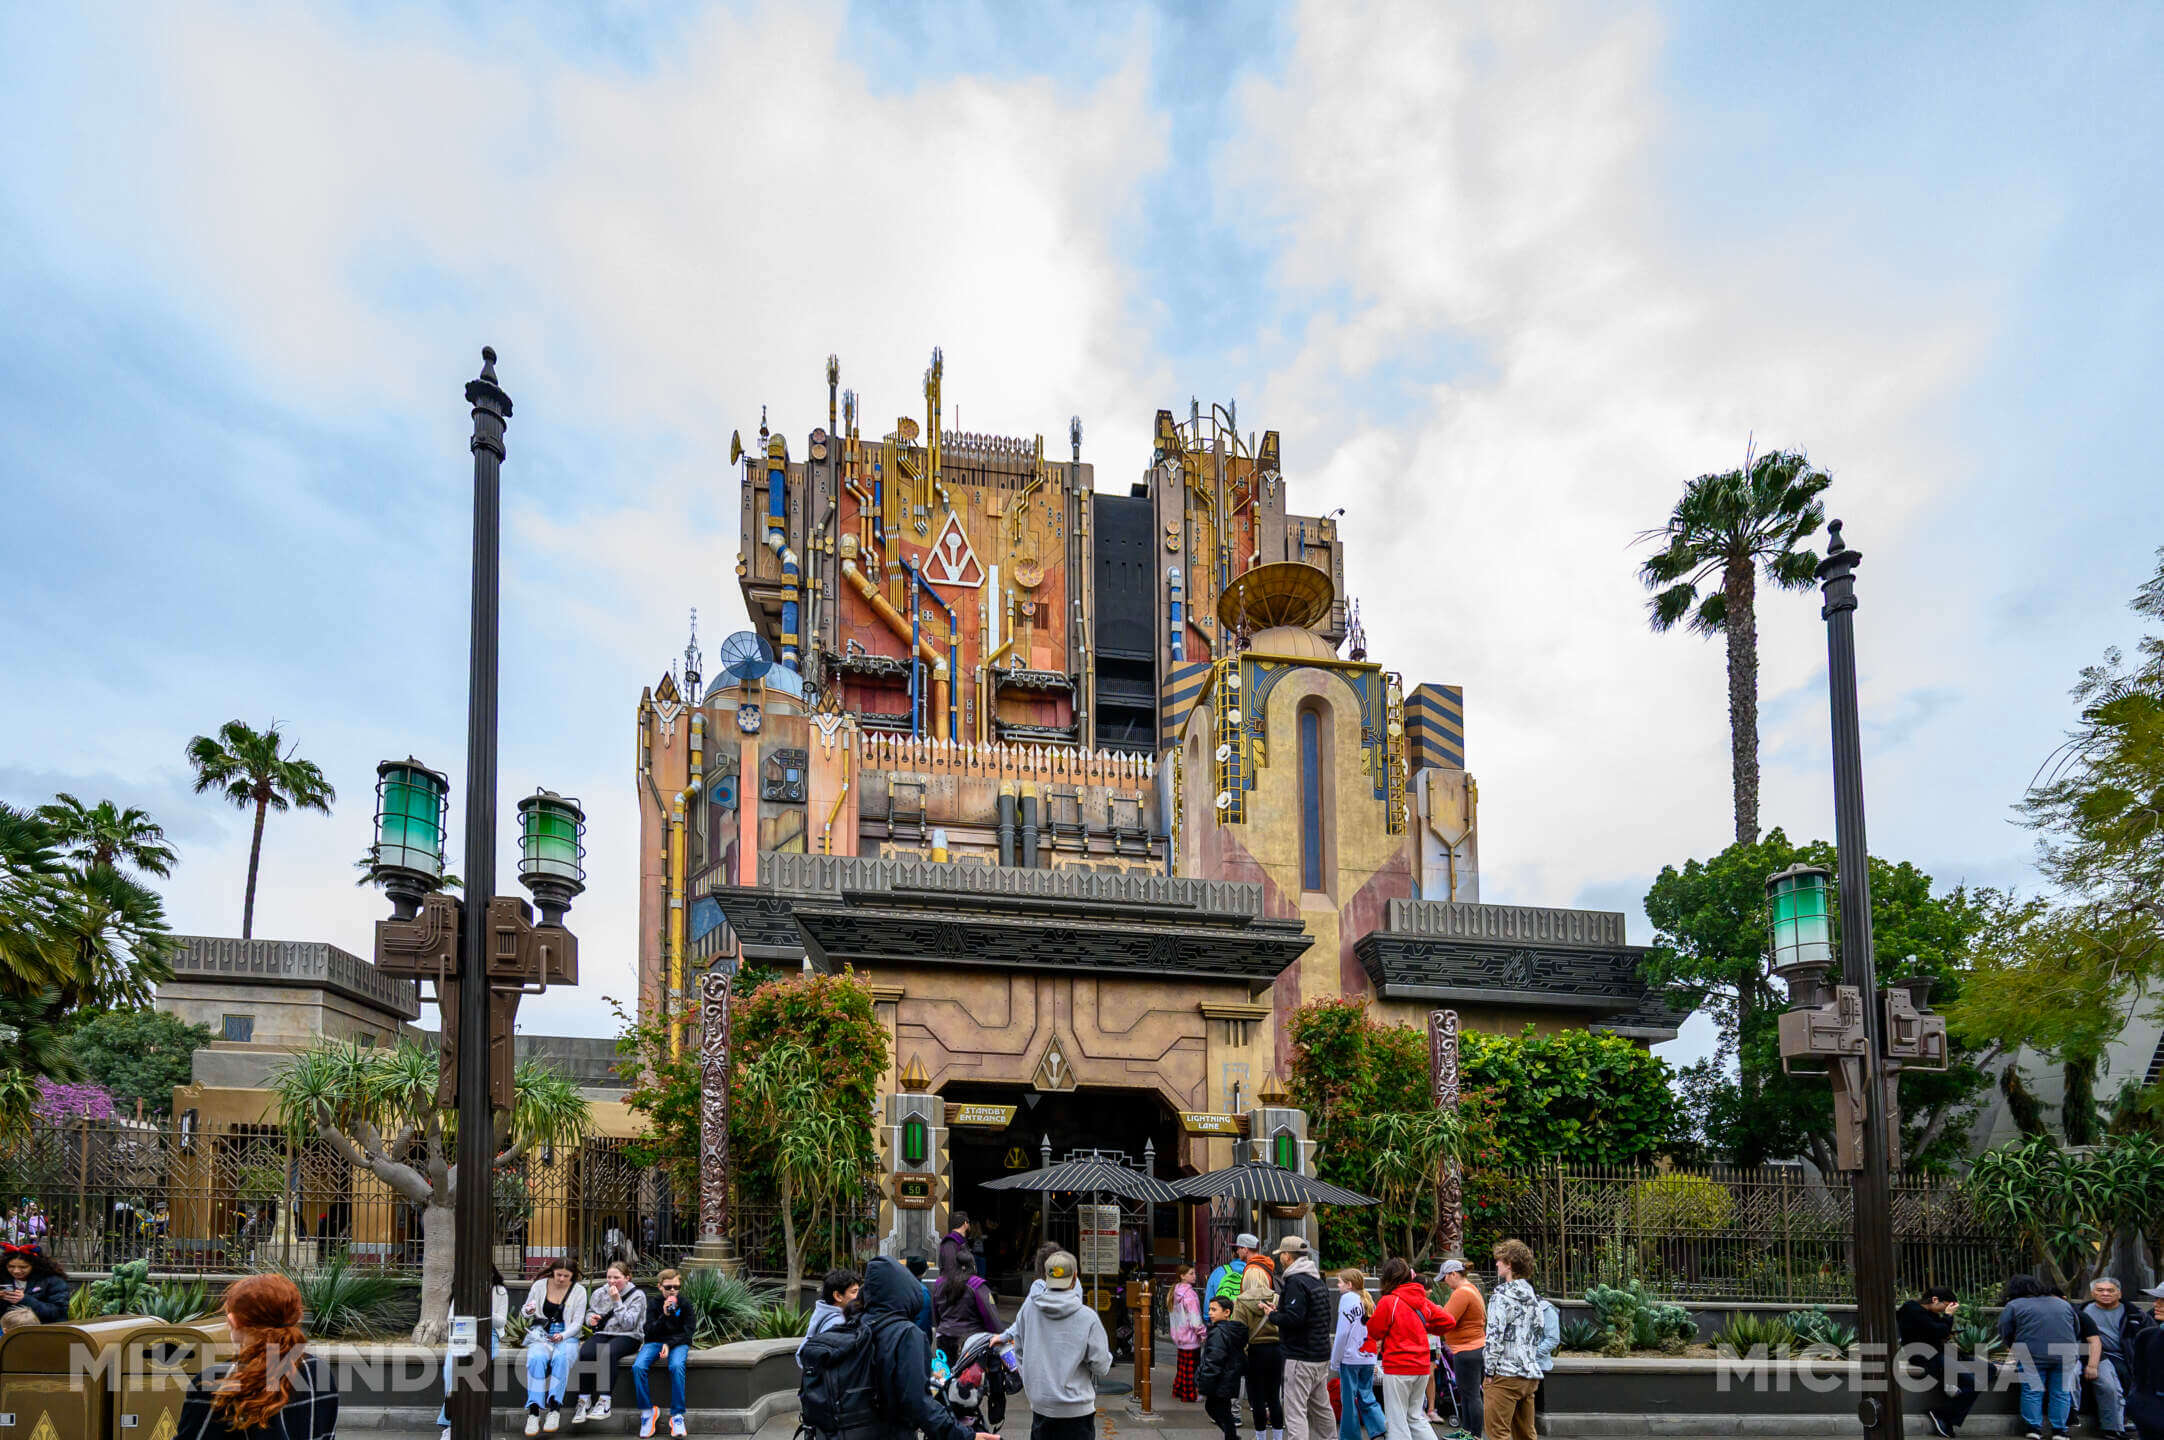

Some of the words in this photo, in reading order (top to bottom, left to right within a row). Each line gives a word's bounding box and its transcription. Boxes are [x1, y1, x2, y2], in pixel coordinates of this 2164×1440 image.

[965, 1107, 1006, 1115] STANDBY
[960, 1114, 1006, 1122] ENTRANCE
[1186, 1115, 1231, 1123] LIGHTNING
[908, 1185, 921, 1194] 50
